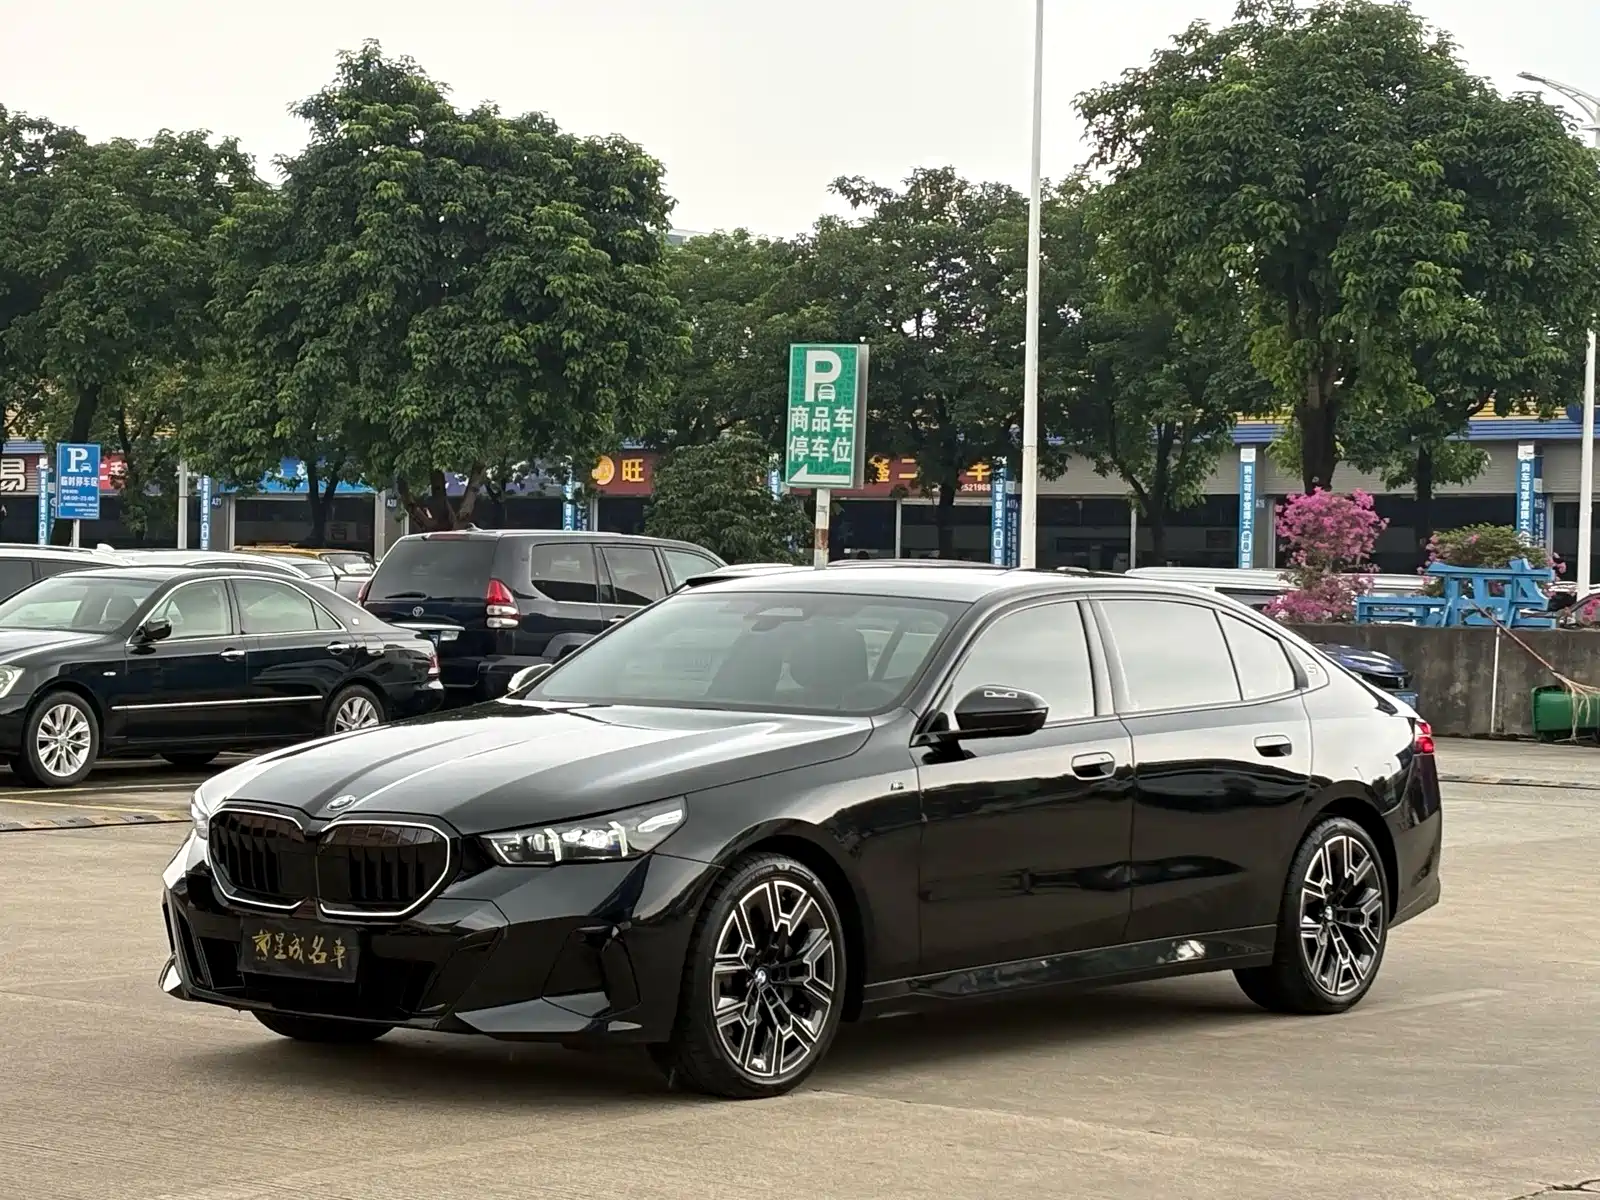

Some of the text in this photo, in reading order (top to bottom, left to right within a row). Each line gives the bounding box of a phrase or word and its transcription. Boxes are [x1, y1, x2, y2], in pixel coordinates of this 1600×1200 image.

[804, 350, 842, 403] P
[790, 405, 854, 433] 商品车
[66, 447, 88, 473] P
[788, 436, 852, 463] 停车位
[0, 458, 26, 492] 易
[61, 476, 98, 488] 临时停车区
[621, 458, 645, 482] 旺
